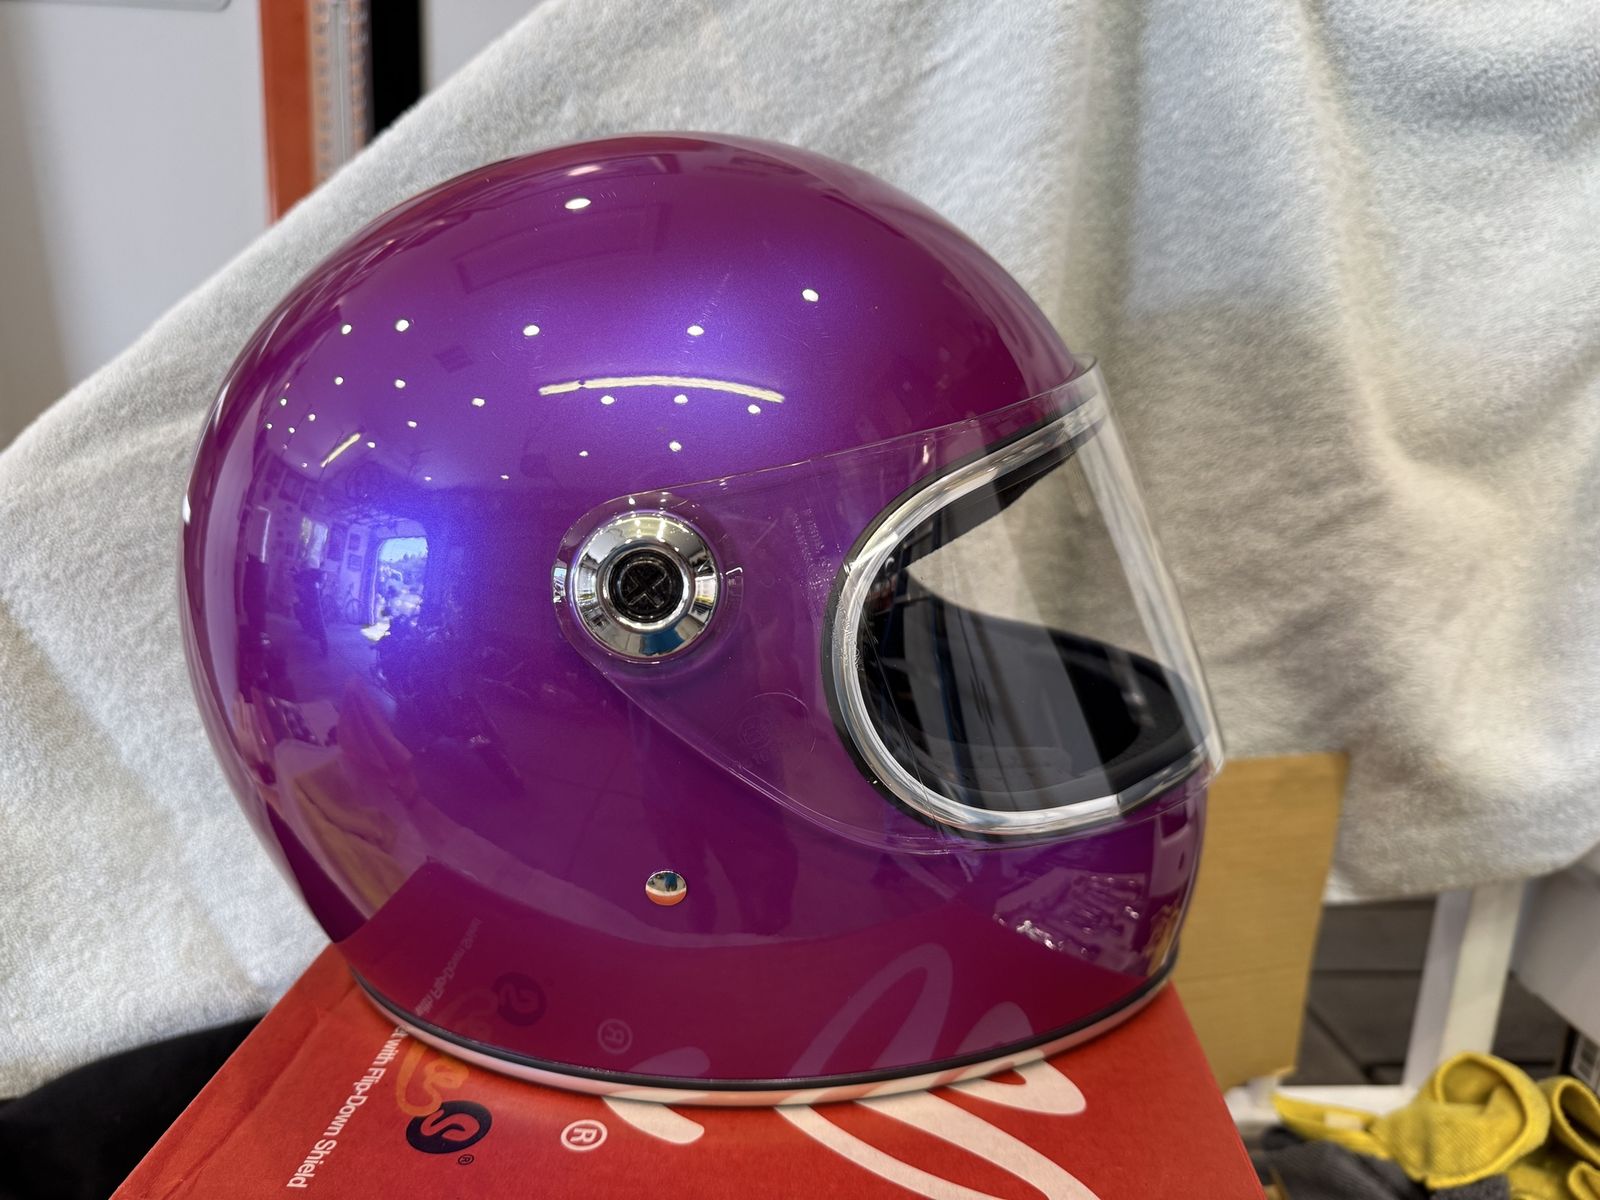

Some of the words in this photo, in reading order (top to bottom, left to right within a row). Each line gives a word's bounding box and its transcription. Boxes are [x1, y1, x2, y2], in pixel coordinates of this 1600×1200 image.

[373, 1038, 403, 1065] with
[323, 1067, 387, 1136] Flip-Down
[286, 1139, 337, 1188] Shield
